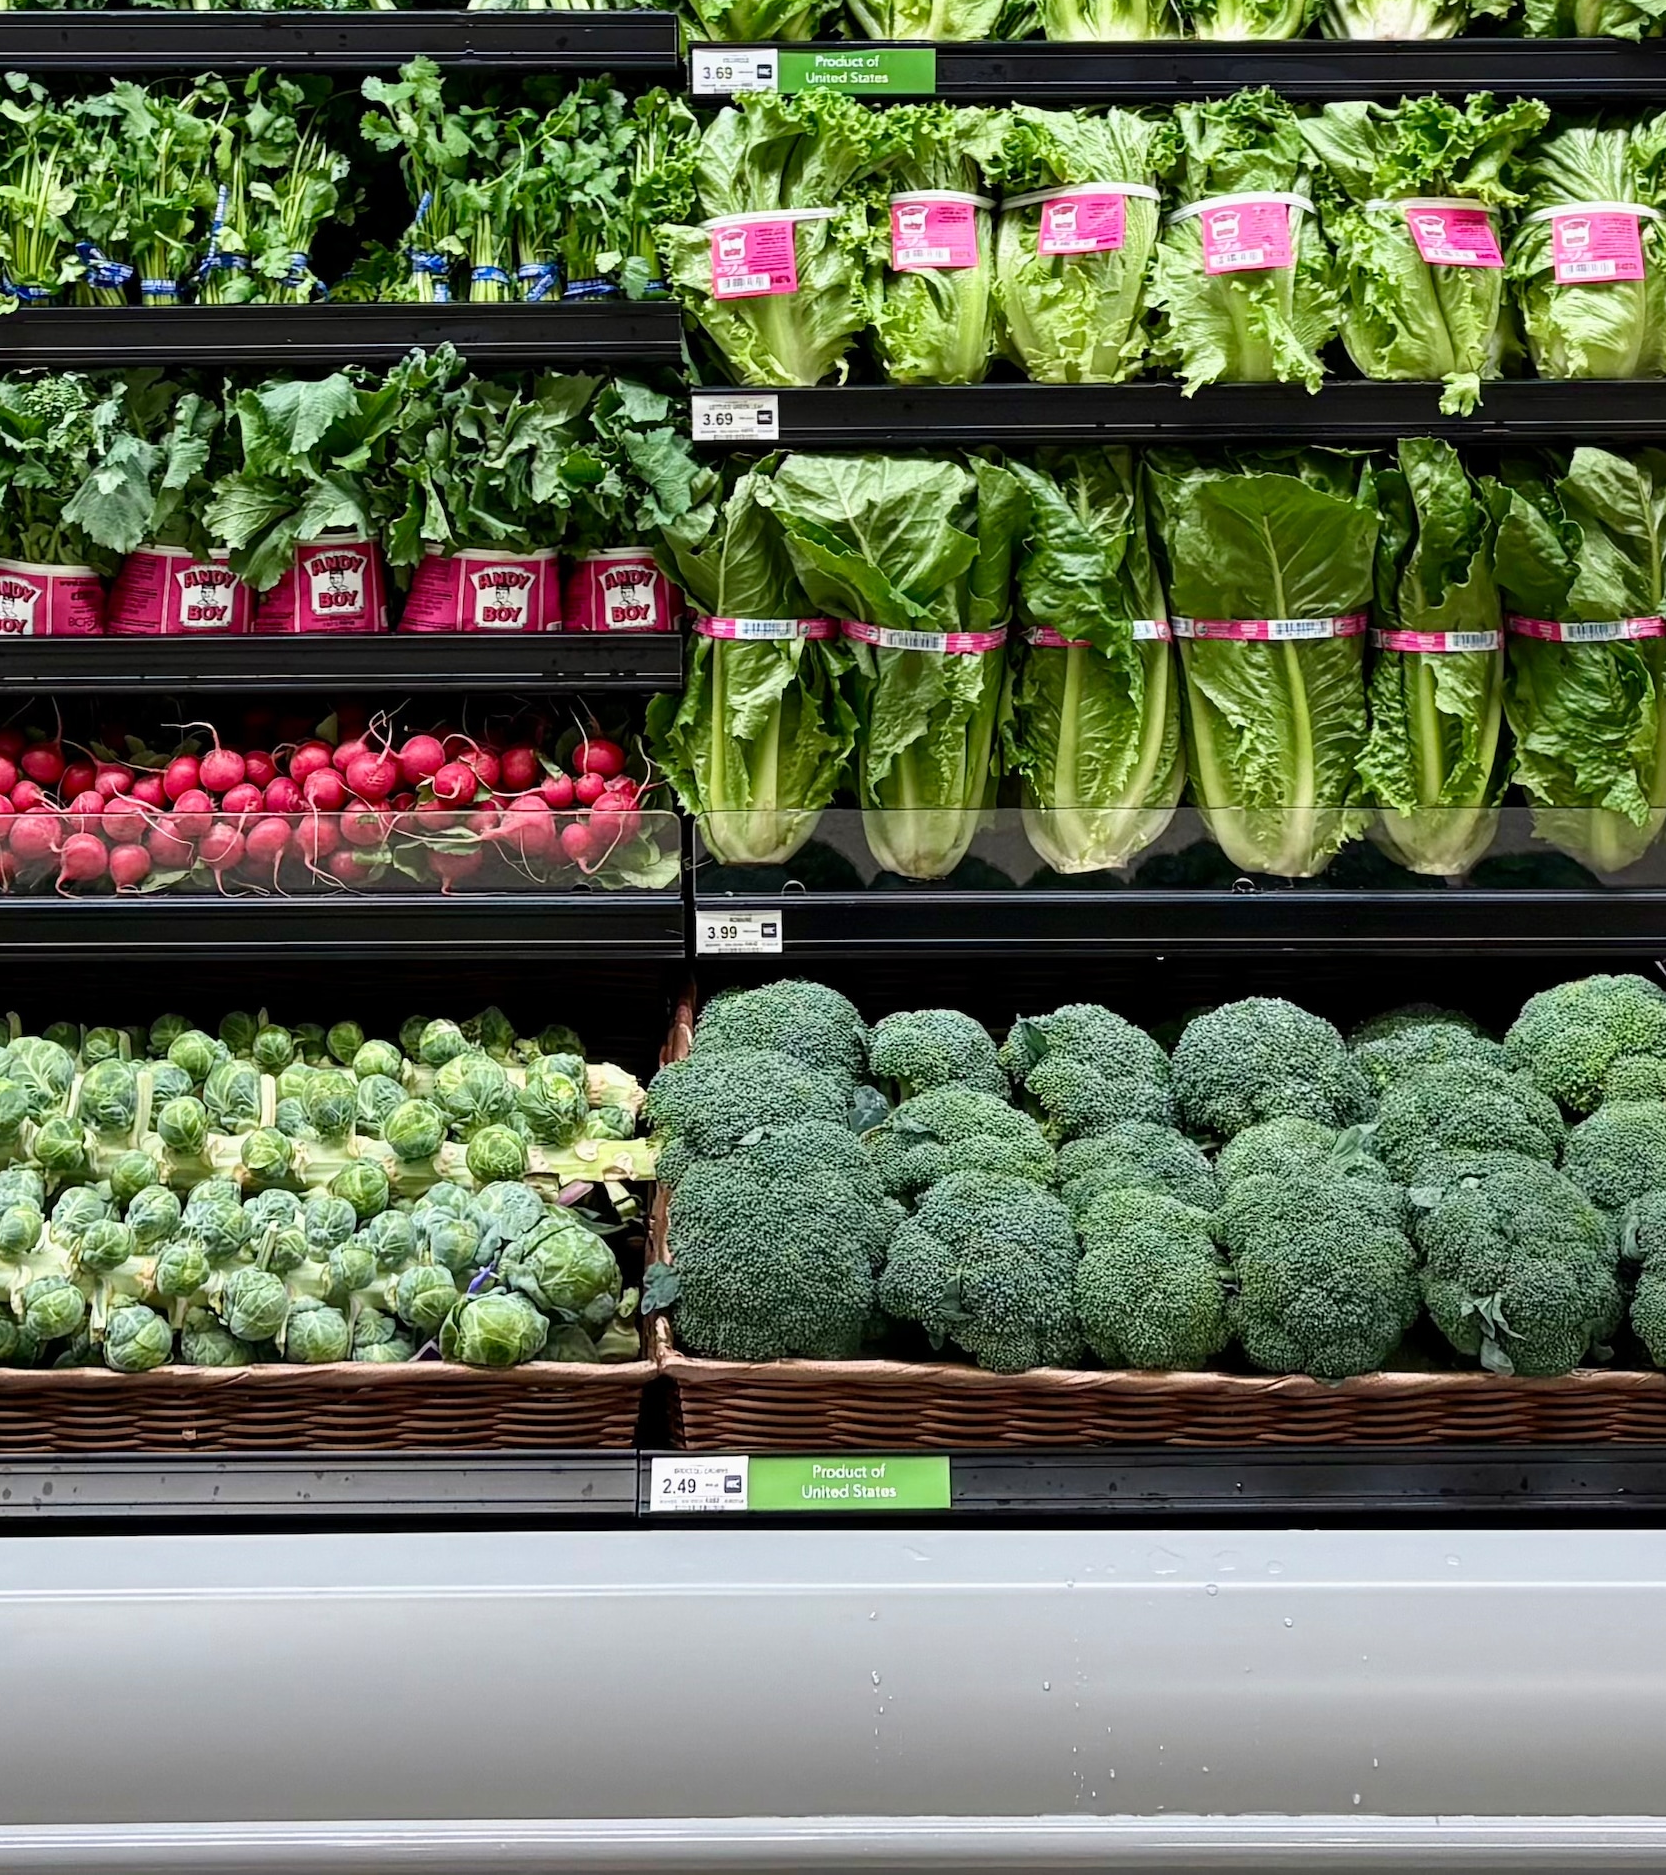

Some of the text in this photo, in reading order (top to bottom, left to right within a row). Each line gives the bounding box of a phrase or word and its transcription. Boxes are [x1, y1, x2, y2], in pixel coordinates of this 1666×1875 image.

[815, 54, 881, 68] Product of
[702, 66, 734, 80] 3.69
[805, 71, 890, 84] United States
[702, 412, 734, 426] 3.69
[311, 554, 365, 575] ANDY
[183, 569, 237, 589] ANDY
[478, 571, 532, 590] ANDY
[604, 570, 654, 591] ANDY
[317, 589, 360, 610] BOY
[186, 604, 228, 622] BOY
[482, 605, 524, 623] BOY
[610, 603, 652, 623] BOY
[707, 925, 738, 940] 3.99
[812, 1463, 887, 1479] Product of
[661, 1478, 697, 1494] 2.49
[801, 1484, 898, 1499] United States
